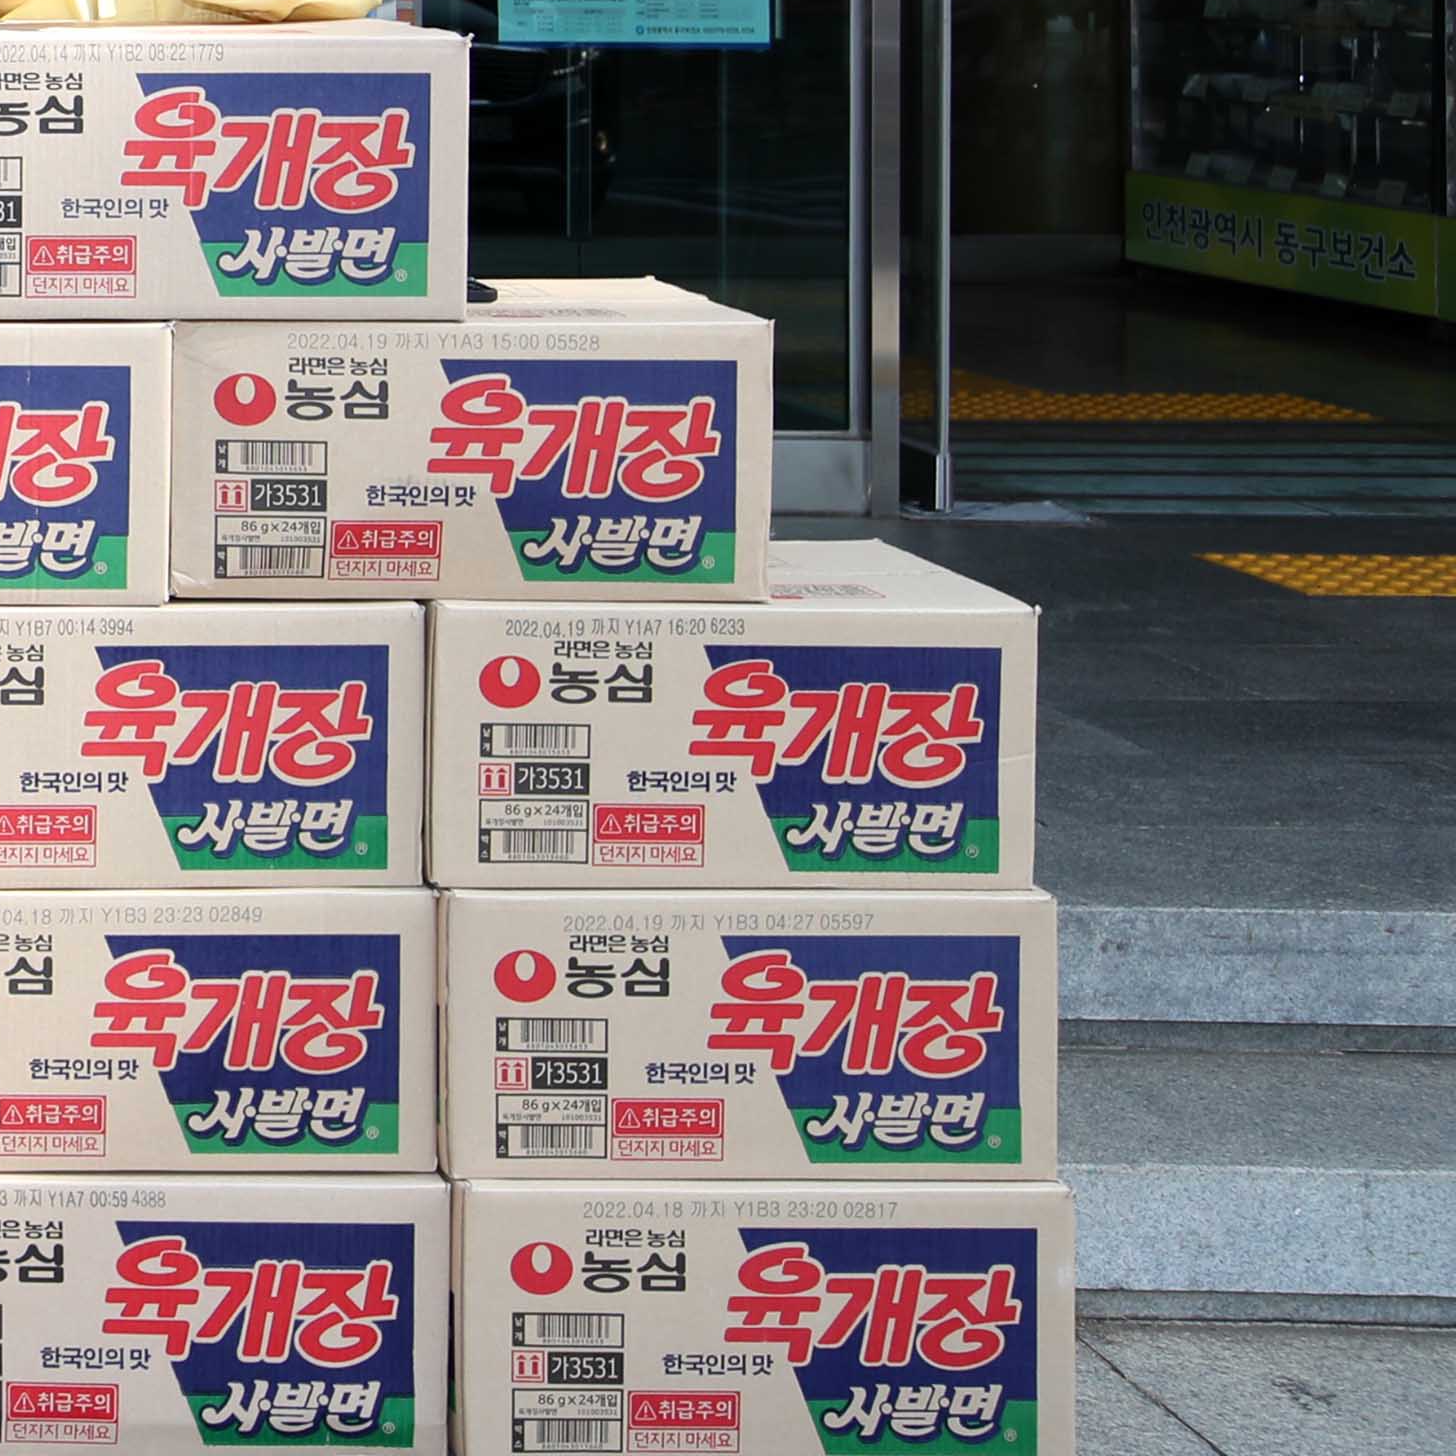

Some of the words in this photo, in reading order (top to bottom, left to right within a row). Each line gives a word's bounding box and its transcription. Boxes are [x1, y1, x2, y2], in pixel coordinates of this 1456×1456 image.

[120, 88, 413, 211] 육개장
[219, 229, 396, 282] 사발면
[1142, 201, 1264, 259] 인천광역시
[1274, 221, 1417, 280] 동구보건소
[288, 331, 387, 349] 2022.04.19
[493, 331, 539, 350] 15:00
[284, 380, 389, 421] 농심
[425, 376, 720, 499] 육개장
[524, 515, 703, 569] 사발면
[549, 662, 653, 705] 농심
[79, 661, 371, 782] 육개장
[688, 659, 983, 785] 육개장
[177, 800, 354, 852] 사발면
[786, 801, 965, 856] 사발면
[565, 957, 670, 998] 농심
[89, 951, 383, 1071] 육개장
[706, 952, 1002, 1075] 육개장
[188, 1089, 366, 1141] 사발면
[806, 1093, 986, 1146] 사발면
[584, 1200, 683, 1218] 2022.04.18
[788, 1199, 837, 1218] 23:20
[844, 1199, 897, 1218] 02817
[581, 1252, 686, 1292] 농심
[101, 1238, 397, 1364] 육개장
[723, 1245, 1020, 1367] 육개장
[201, 1380, 382, 1434] 사발면
[823, 1385, 1003, 1437] 사발면
